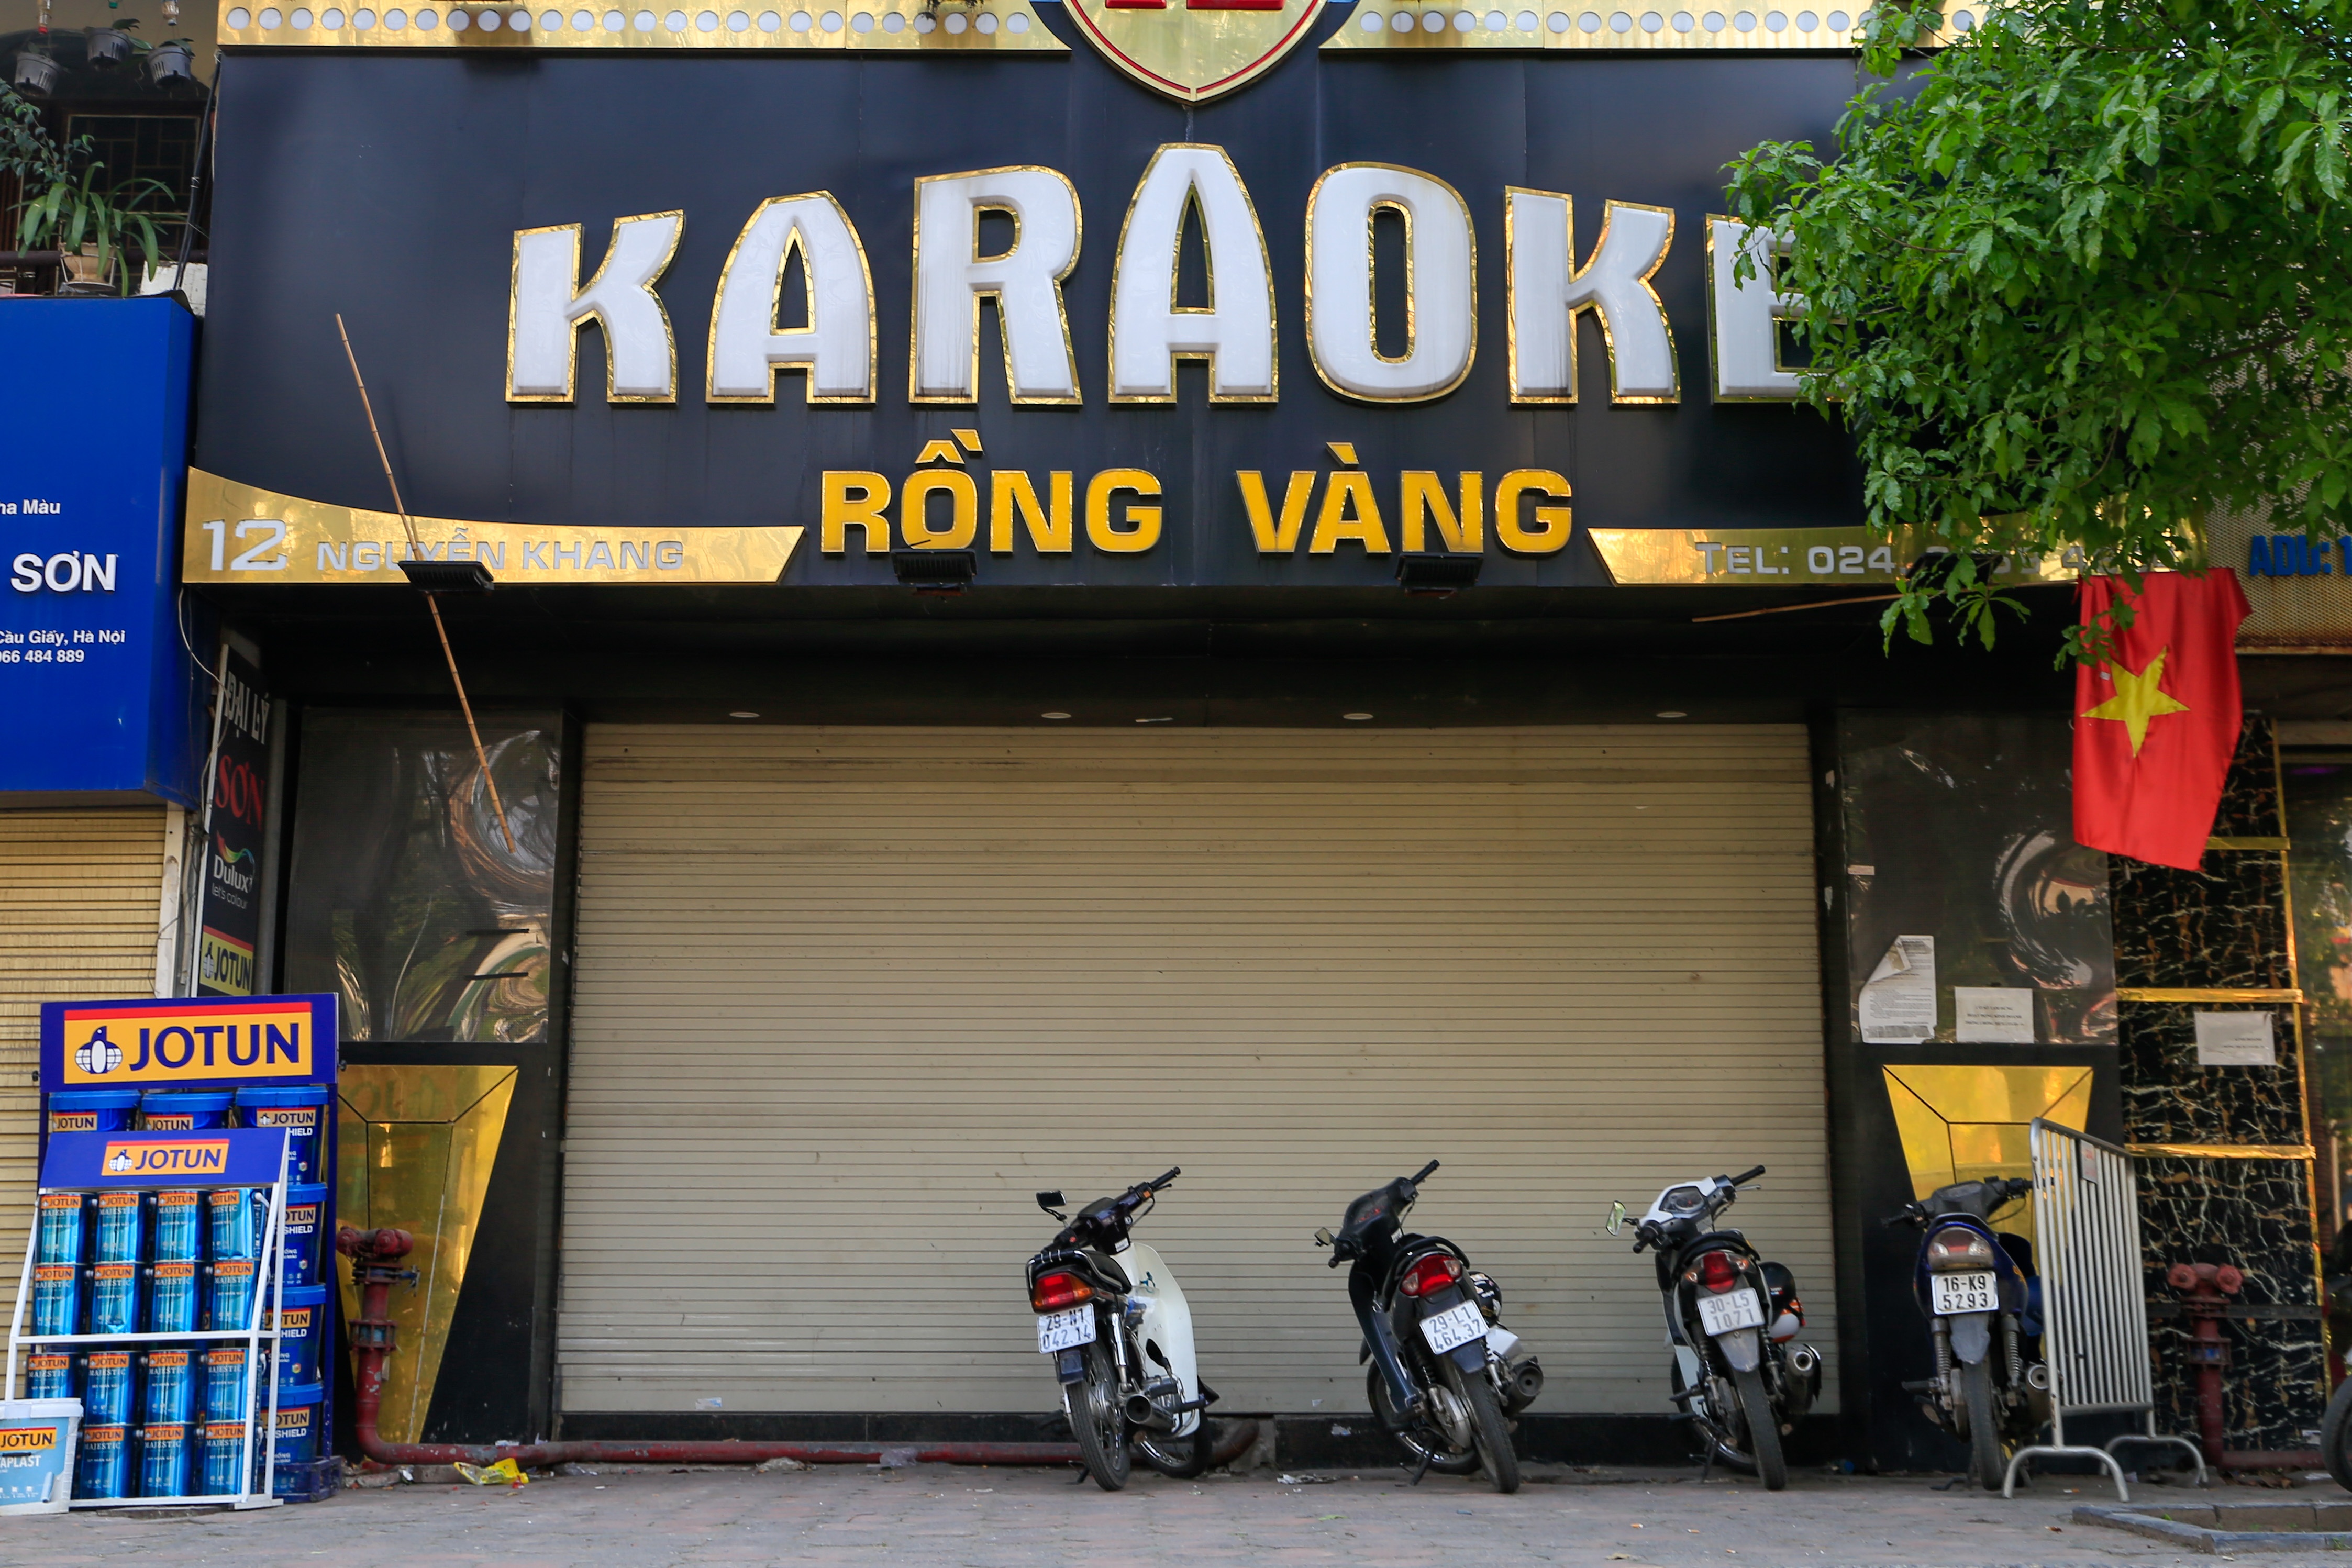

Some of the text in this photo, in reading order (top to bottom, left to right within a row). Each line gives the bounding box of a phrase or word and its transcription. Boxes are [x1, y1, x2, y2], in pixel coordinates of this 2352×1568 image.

[820, 429, 1572, 554] RỒNG VÀNG
[23, 499, 61, 515] Màu
[203, 520, 287, 571] 12
[523, 541, 683, 570] KHANG
[1695, 542, 1790, 574] TEL:
[10, 550, 117, 592] SƠN
[28, 630, 69, 647] Giấy,
[73, 630, 95, 643] Hà
[98, 630, 126, 645] Nội
[0, 649, 85, 663] 66 484 889
[213, 854, 249, 893] Dulux
[226, 891, 248, 910] colour
[214, 946, 252, 991] JOTUN
[129, 1022, 299, 1071] JOTUN
[57, 1117, 94, 1129] JOTUN
[151, 1120, 190, 1130] JOTUN
[272, 1112, 314, 1125] JOTUN
[289, 1127, 314, 1137] HIELD
[135, 1148, 221, 1170] JOTUN
[49, 1198, 79, 1206] JOTUN
[285, 1209, 314, 1221] TUN
[284, 1225, 313, 1235] SHIELD
[101, 1268, 131, 1276] JOTUN
[161, 1266, 192, 1275] JOTUN
[1943, 1275, 1987, 1293] 16-K9
[1943, 1292, 1988, 1309] 5293
[265, 1313, 308, 1326] JTUN
[1047, 1308, 1084, 1331] 29-N1
[1429, 1306, 1471, 1333] 29-L1
[1712, 1309, 1755, 1330] 1071
[281, 1328, 307, 1338] HIELD
[1042, 1325, 1091, 1350] 042.14
[1434, 1319, 1481, 1350] 464.37
[36, 1359, 66, 1367] JOTUN
[96, 1358, 126, 1366] JOTUN
[276, 1412, 308, 1425] OTUN
[1, 1433, 53, 1448] JOTUN
[91, 1431, 121, 1439] JOTUN
[152, 1429, 182, 1438] JOTUN
[275, 1428, 307, 1439] SHIELD
[0, 1455, 41, 1468] APLAST
